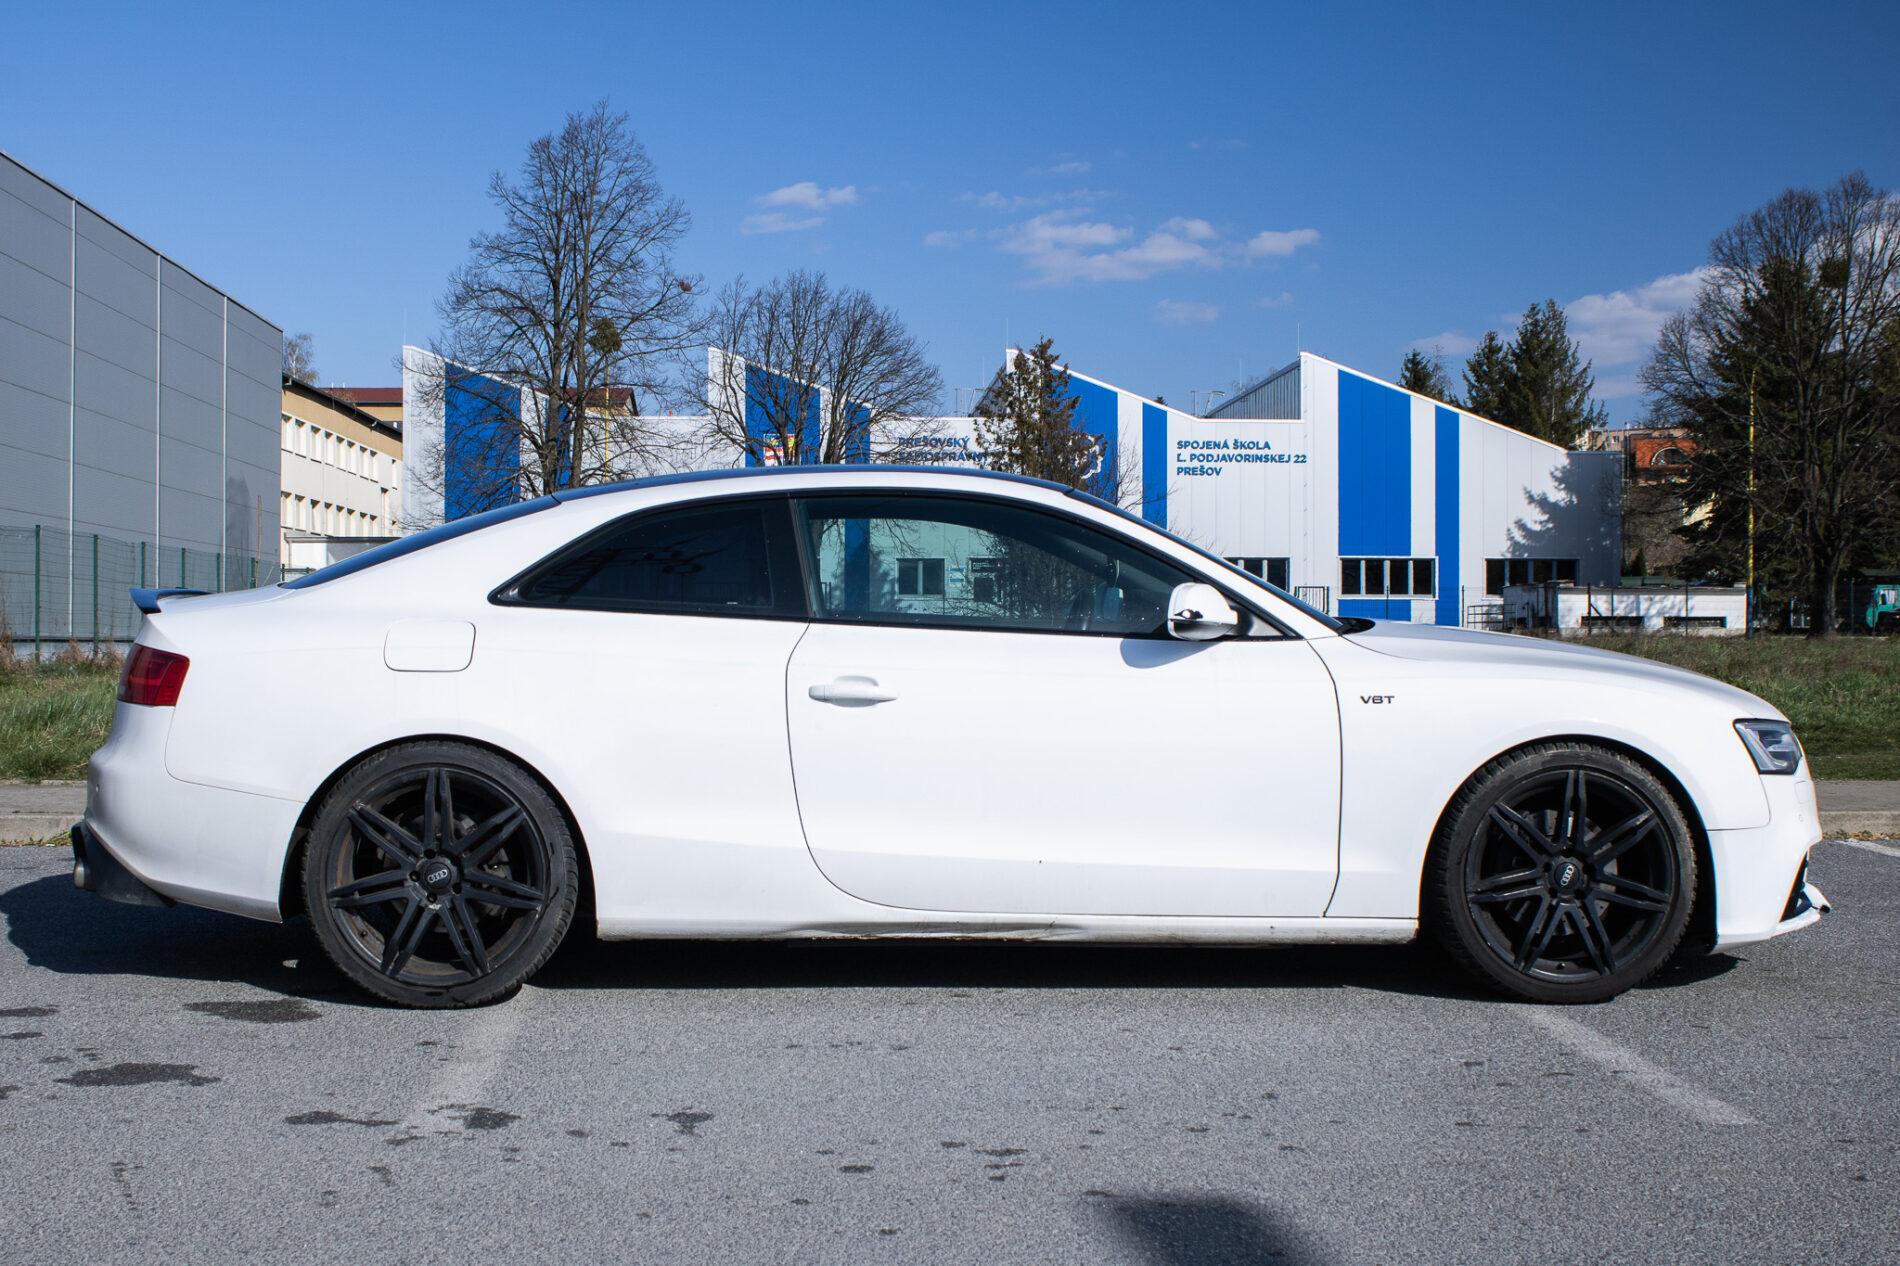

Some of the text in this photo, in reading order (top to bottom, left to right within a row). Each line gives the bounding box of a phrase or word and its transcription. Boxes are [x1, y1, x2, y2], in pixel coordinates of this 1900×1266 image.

[898, 435, 970, 448] PREŠOVSKÝ
[1176, 438, 1271, 450] SPOJENÁ ŠKOLA
[1190, 453, 1291, 464] PODJAVORINSKEJ
[1293, 454, 1307, 463] 22
[1176, 465, 1222, 476] PREŠOV
